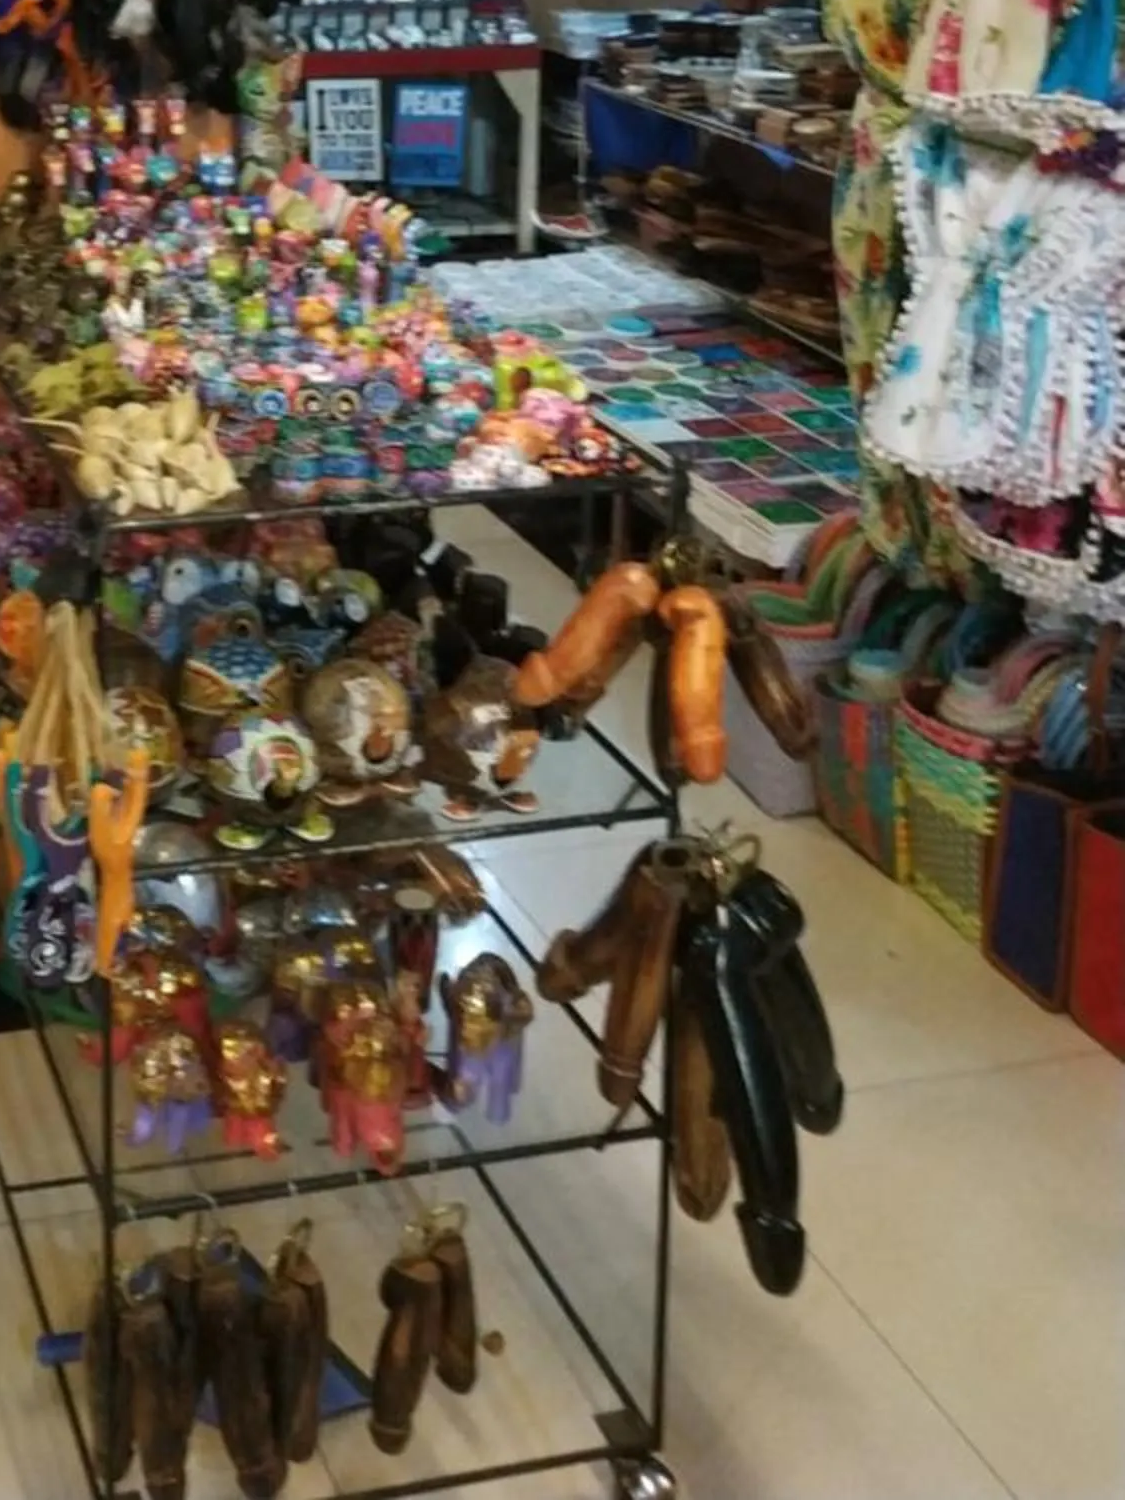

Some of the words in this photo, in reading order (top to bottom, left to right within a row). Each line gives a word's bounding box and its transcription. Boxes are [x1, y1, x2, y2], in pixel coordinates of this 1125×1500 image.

[316, 87, 327, 130] I
[399, 88, 463, 116] PEACE
[330, 108, 375, 131] YOU
